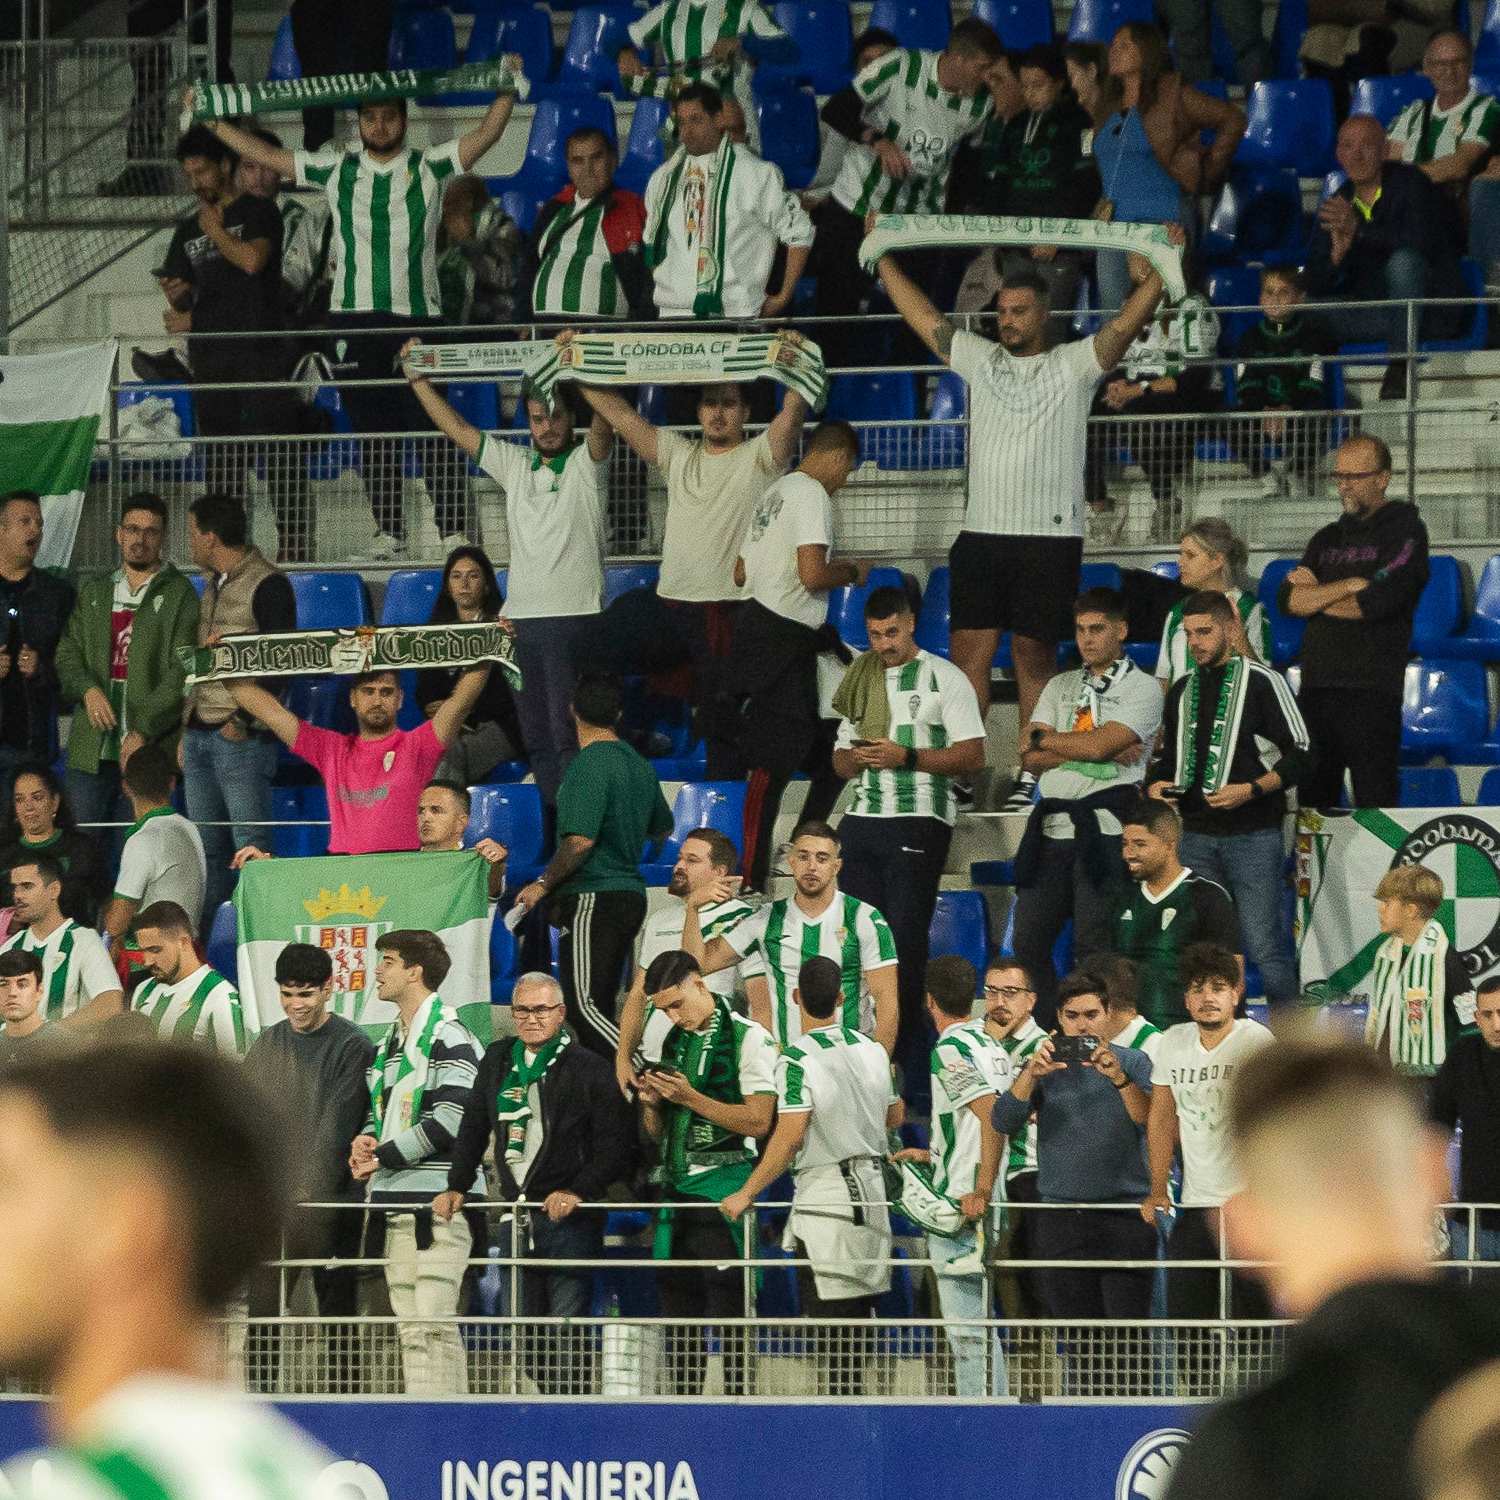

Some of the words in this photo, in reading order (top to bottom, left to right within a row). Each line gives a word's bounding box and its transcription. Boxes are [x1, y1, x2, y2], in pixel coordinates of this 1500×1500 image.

[619, 340, 706, 357] CÓRDOBA
[709, 340, 733, 355] CF
[213, 634, 333, 674] Defend
